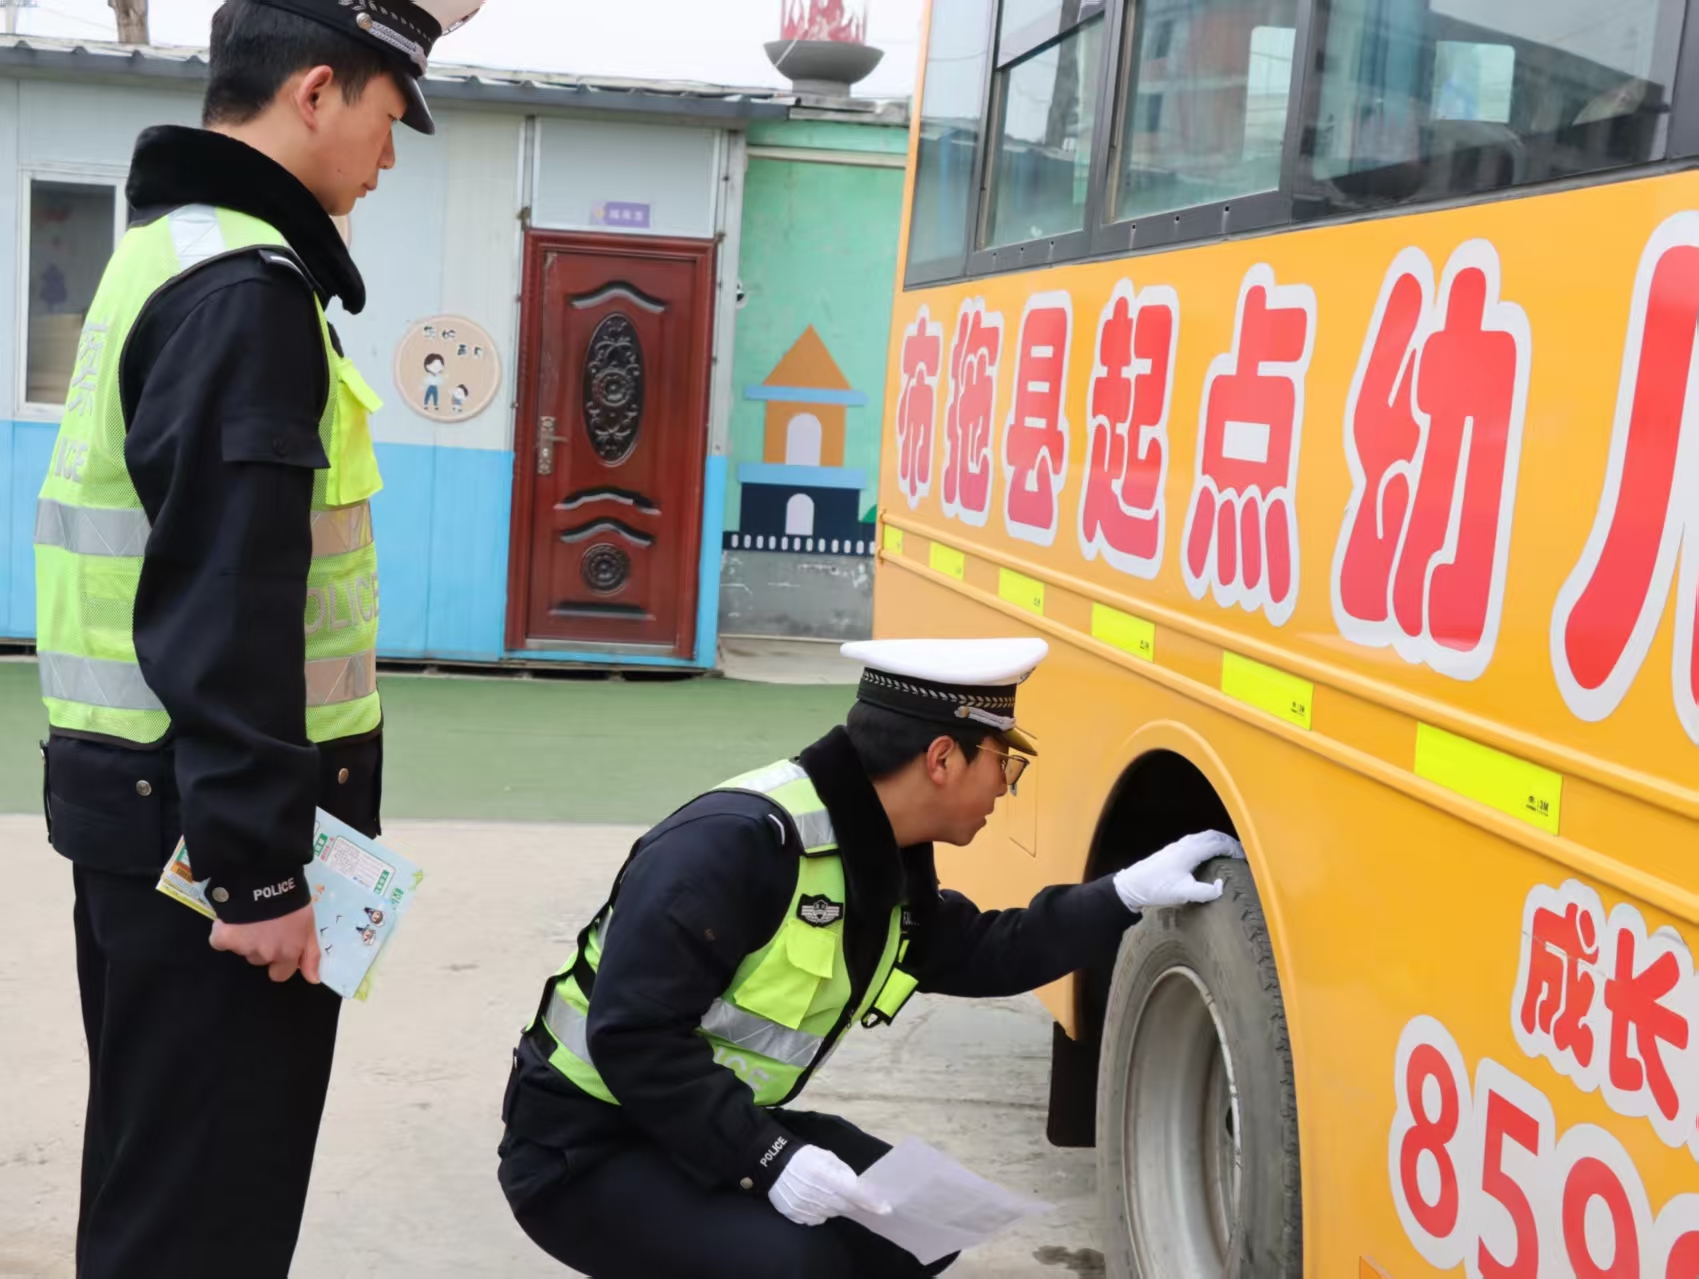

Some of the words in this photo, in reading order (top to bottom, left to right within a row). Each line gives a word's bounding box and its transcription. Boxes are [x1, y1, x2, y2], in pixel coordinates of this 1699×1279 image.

[253, 877, 296, 901] POLICE
[760, 1135, 788, 1168] POLICE
[1395, 1026, 1699, 1279] 859
